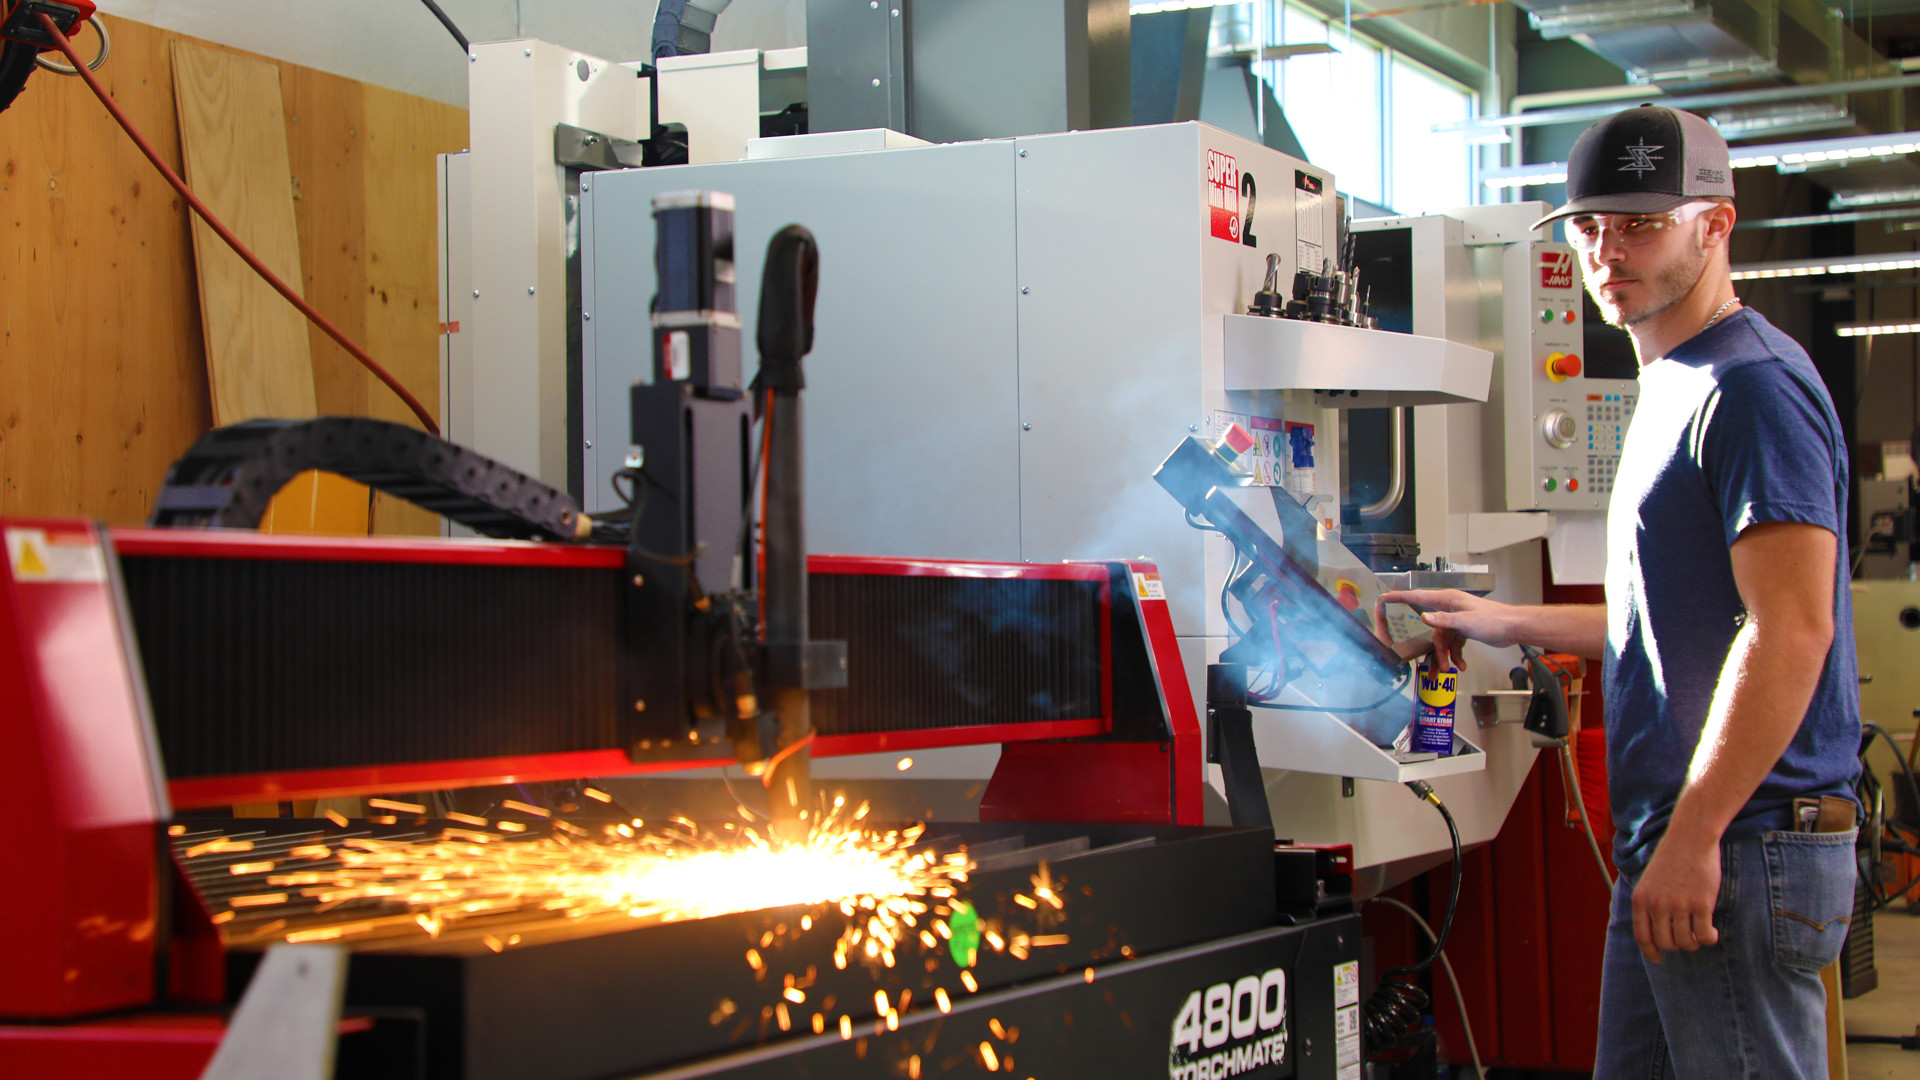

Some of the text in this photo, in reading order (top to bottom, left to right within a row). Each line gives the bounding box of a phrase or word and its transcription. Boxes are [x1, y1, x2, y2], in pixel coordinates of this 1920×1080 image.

[1208, 150, 1237, 187] SUPER
[1208, 181, 1237, 213] Mini Mill
[1242, 172, 1256, 248] 2
[1174, 968, 1285, 1053] 4800
